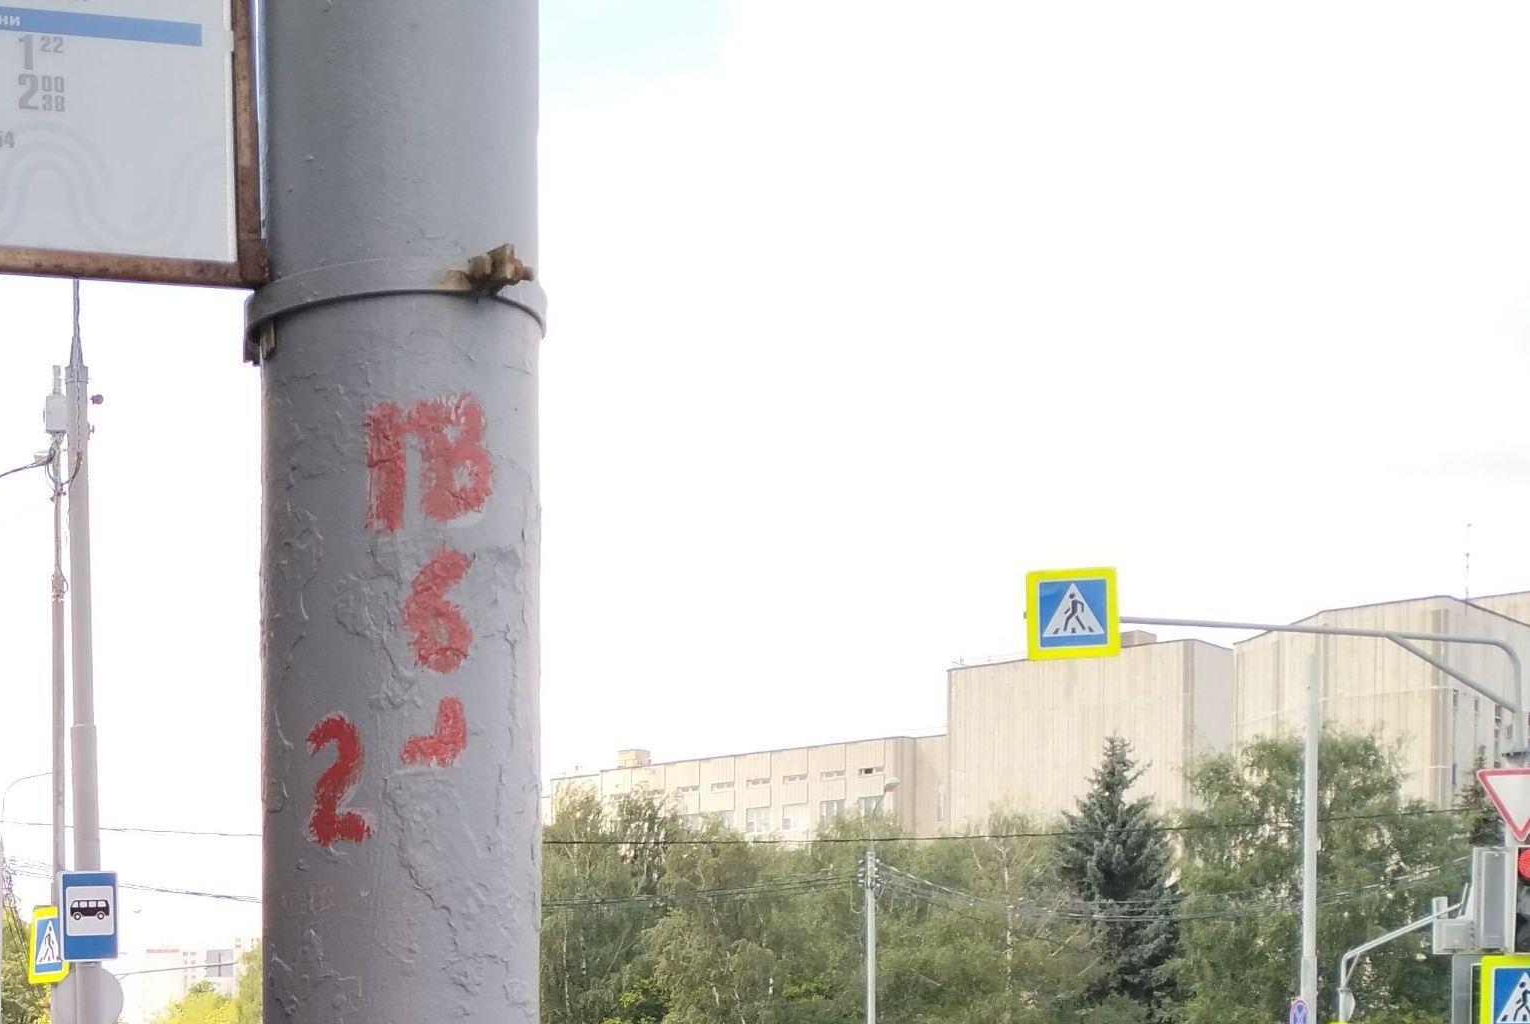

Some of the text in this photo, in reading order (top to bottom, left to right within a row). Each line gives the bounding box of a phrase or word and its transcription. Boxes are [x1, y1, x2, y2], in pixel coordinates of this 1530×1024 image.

[19, 34, 64, 70] 1 22
[19, 74, 65, 110] 2 00
